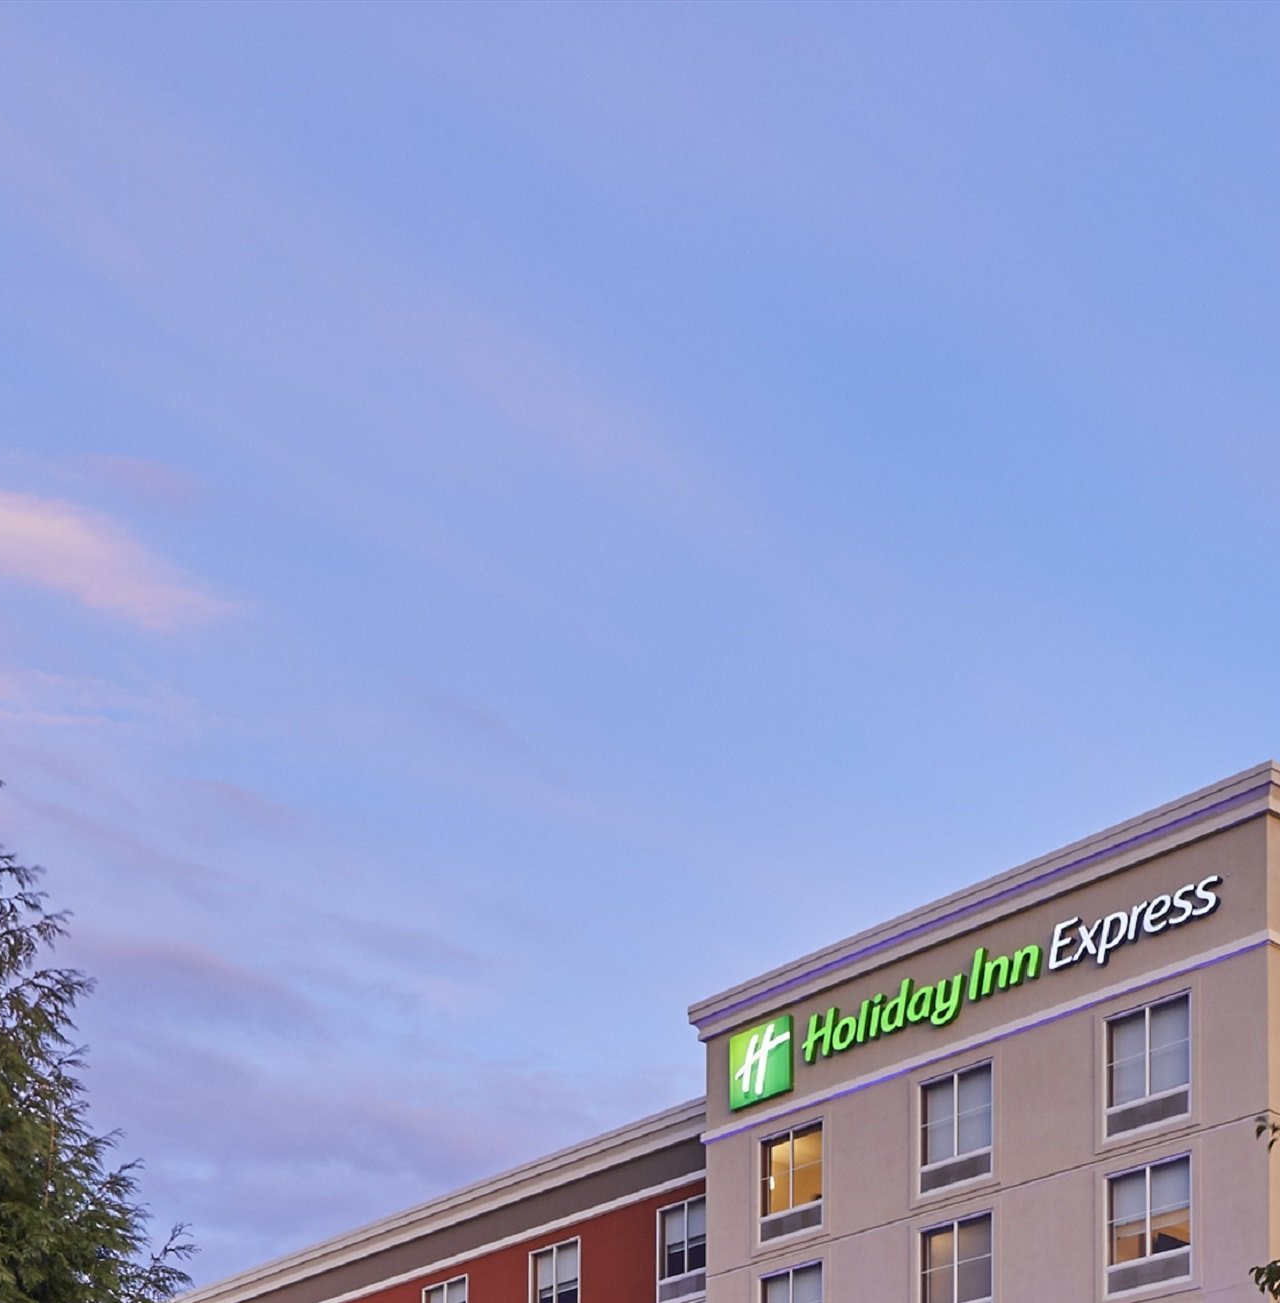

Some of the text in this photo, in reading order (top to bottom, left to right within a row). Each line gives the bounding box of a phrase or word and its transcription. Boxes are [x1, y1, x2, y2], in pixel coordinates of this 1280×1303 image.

[801, 972, 967, 1064] Holiday
[968, 944, 1042, 1001] Inn
[1048, 874, 1221, 970] Express
